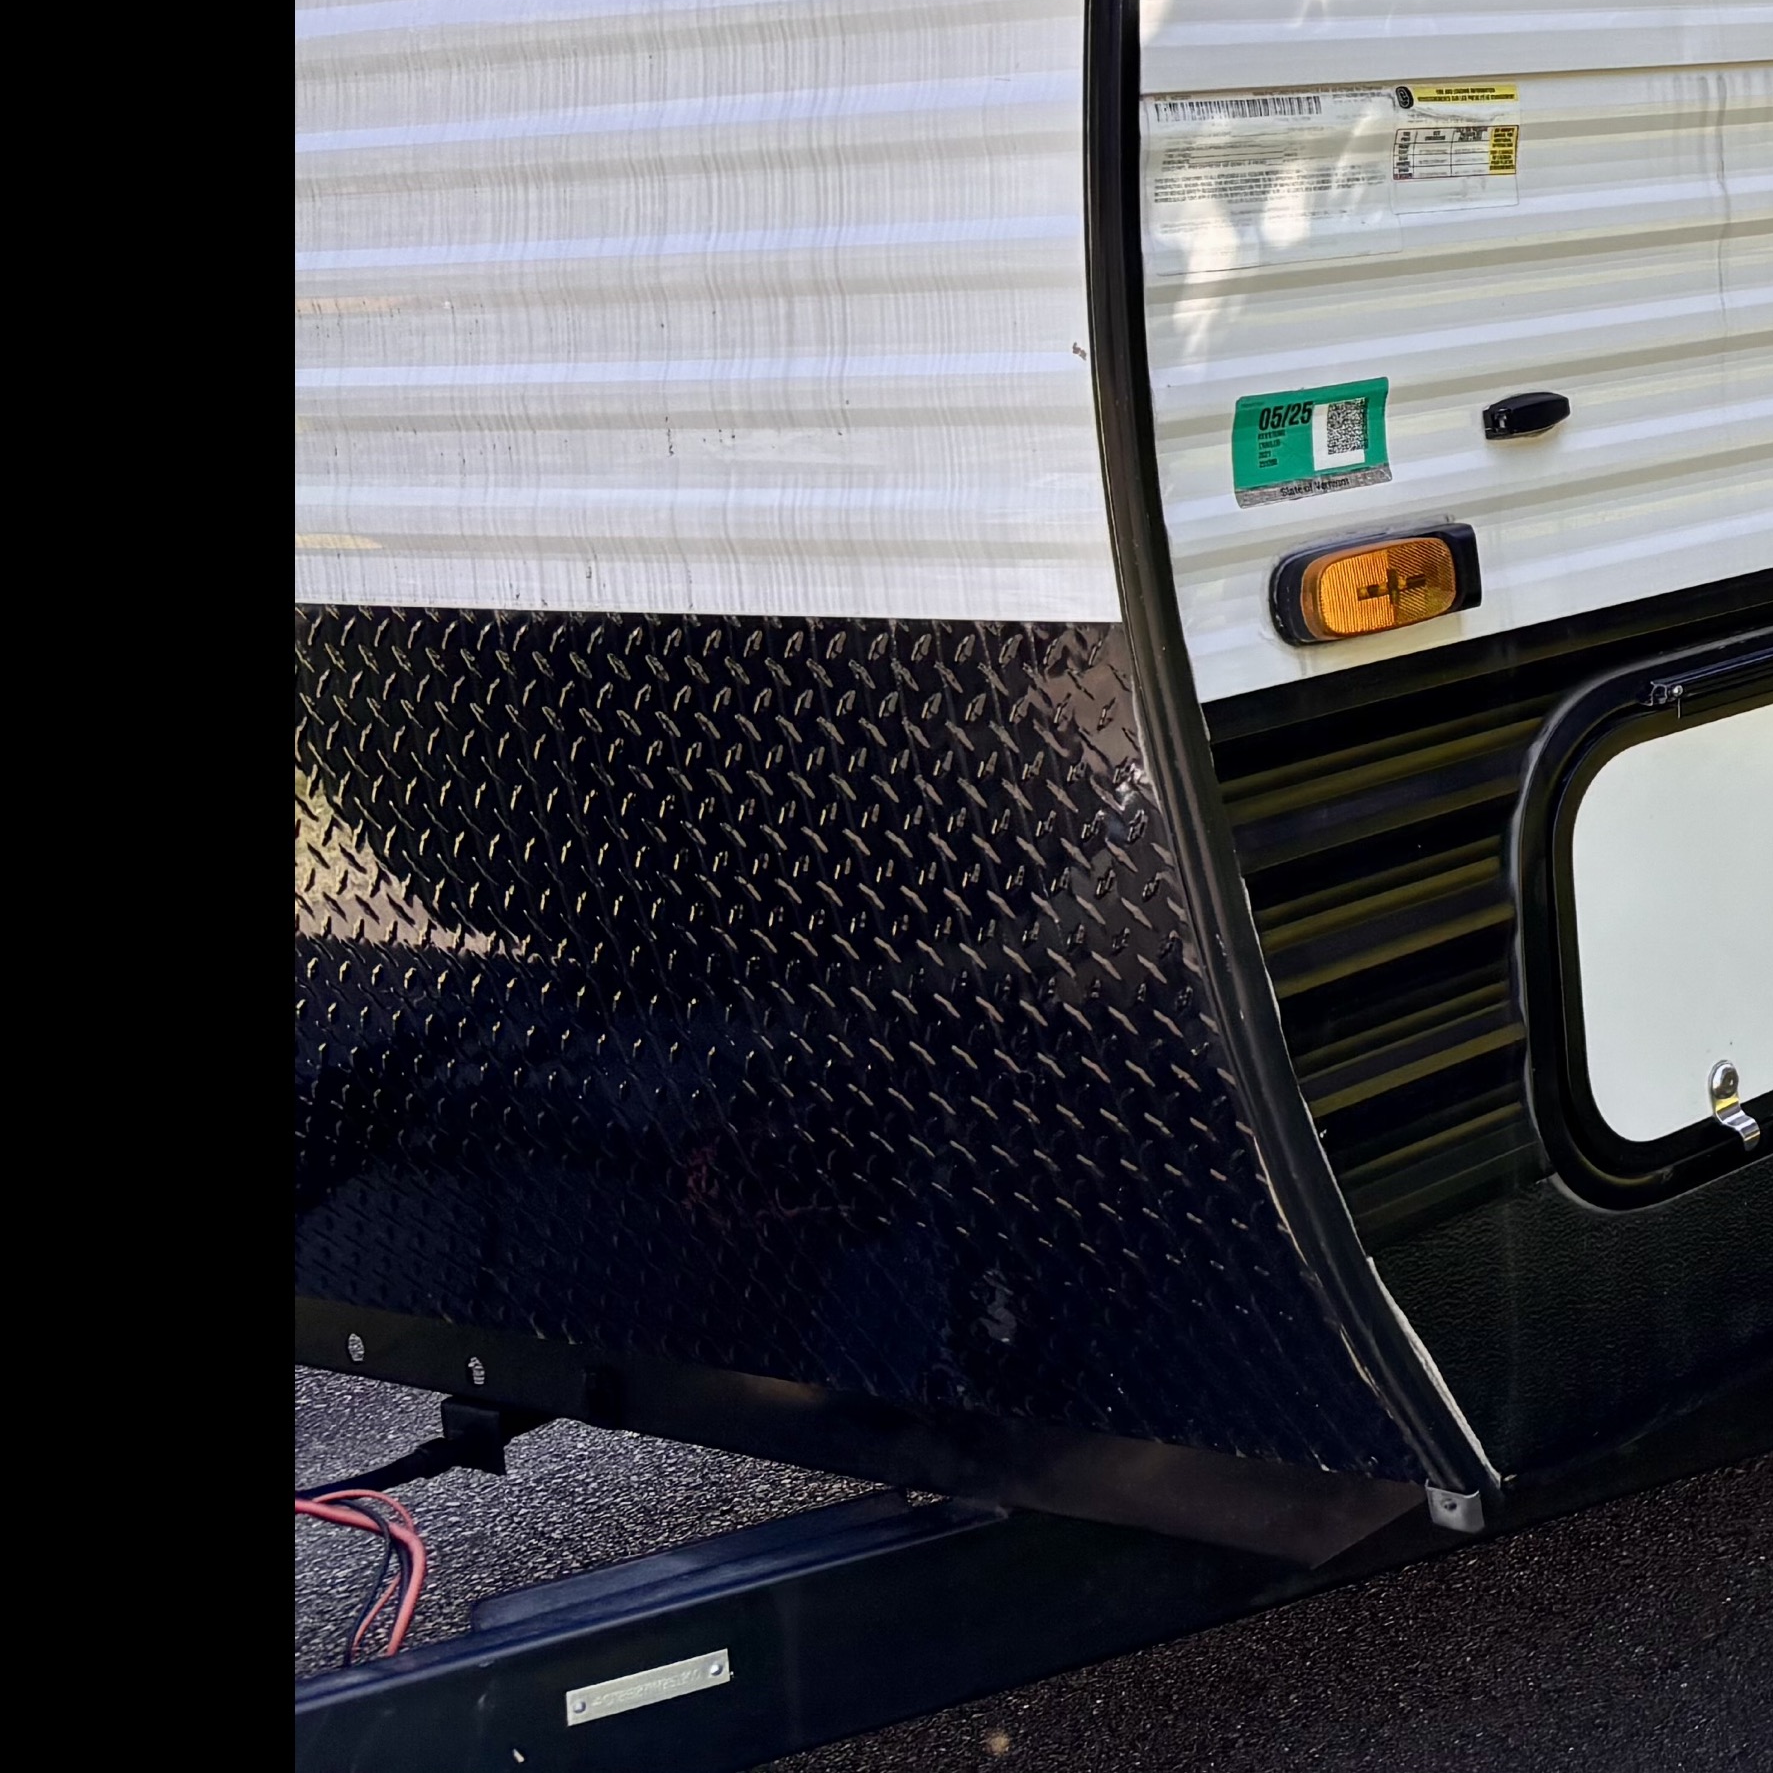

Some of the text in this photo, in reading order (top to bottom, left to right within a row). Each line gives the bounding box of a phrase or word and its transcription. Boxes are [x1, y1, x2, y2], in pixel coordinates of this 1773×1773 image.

[1258, 401, 1314, 430] 05/25
[1280, 477, 1350, 497] State of Vermont
